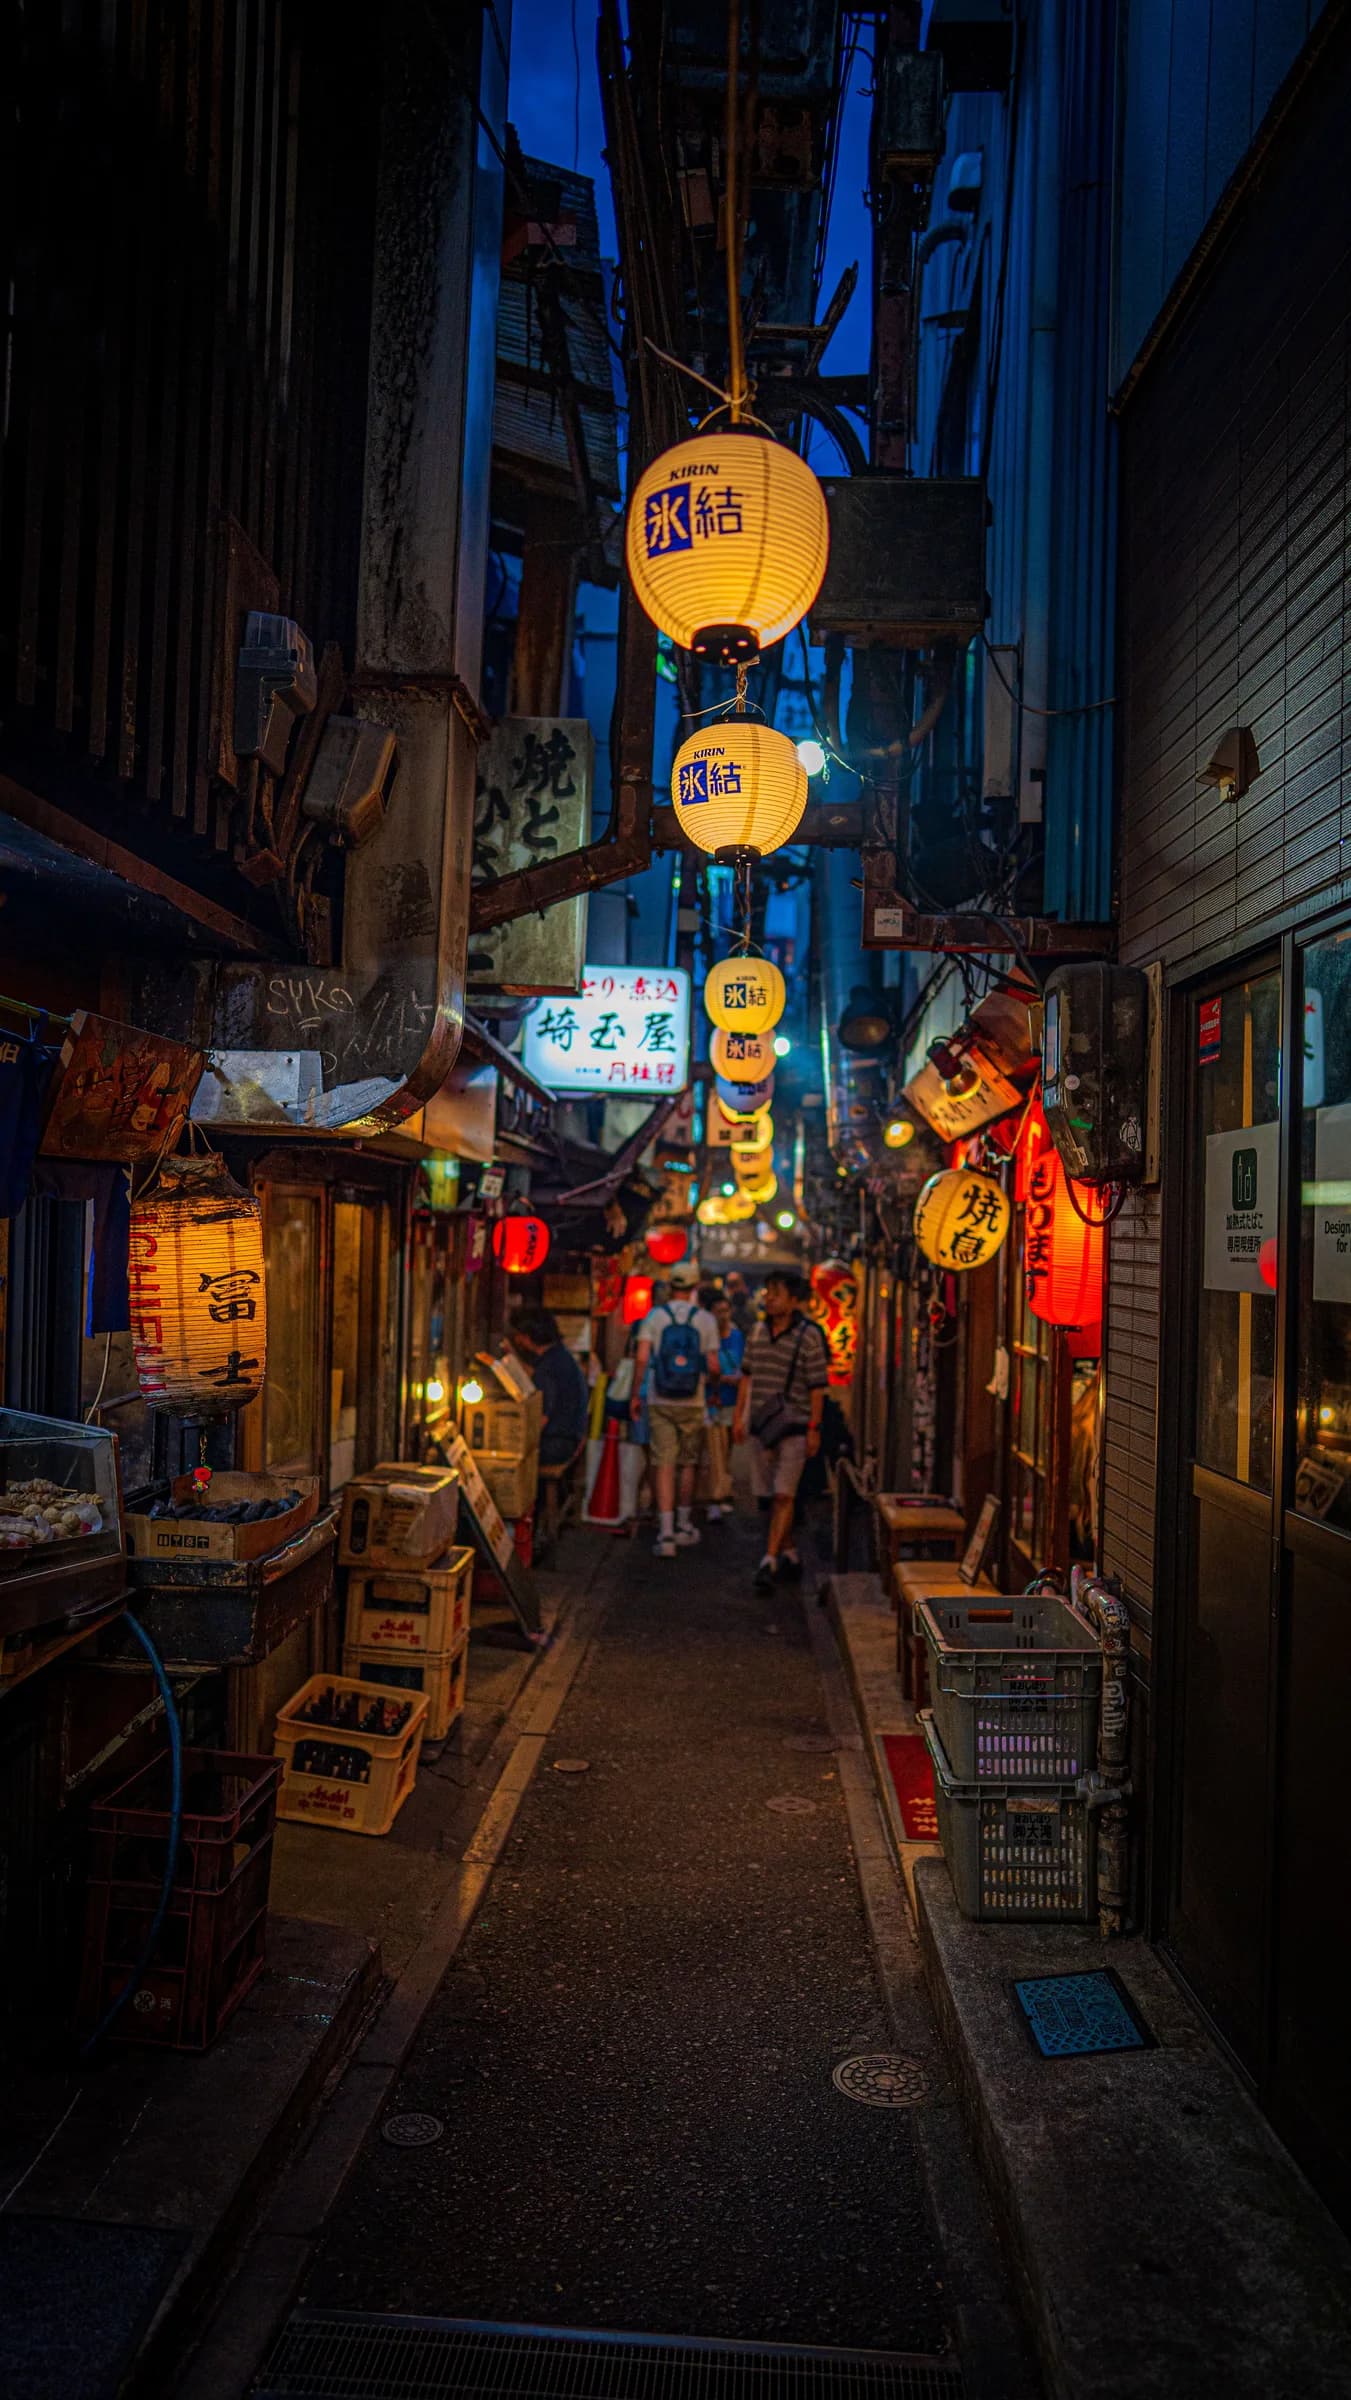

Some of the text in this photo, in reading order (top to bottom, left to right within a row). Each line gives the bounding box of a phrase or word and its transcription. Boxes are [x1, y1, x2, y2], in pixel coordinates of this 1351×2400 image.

[670, 464, 719, 481] KIRIN
[646, 486, 743, 551] 氷結
[693, 747, 725, 760] KIRIN
[680, 762, 742, 801] 氷結
[513, 728, 576, 867] 焼と
[725, 984, 767, 1007] 氷結
[536, 1006, 677, 1053] 埼玉屋
[1226, 1213, 1264, 1231] 加熱式たばこ
[1336, 1238, 1348, 1253] for
